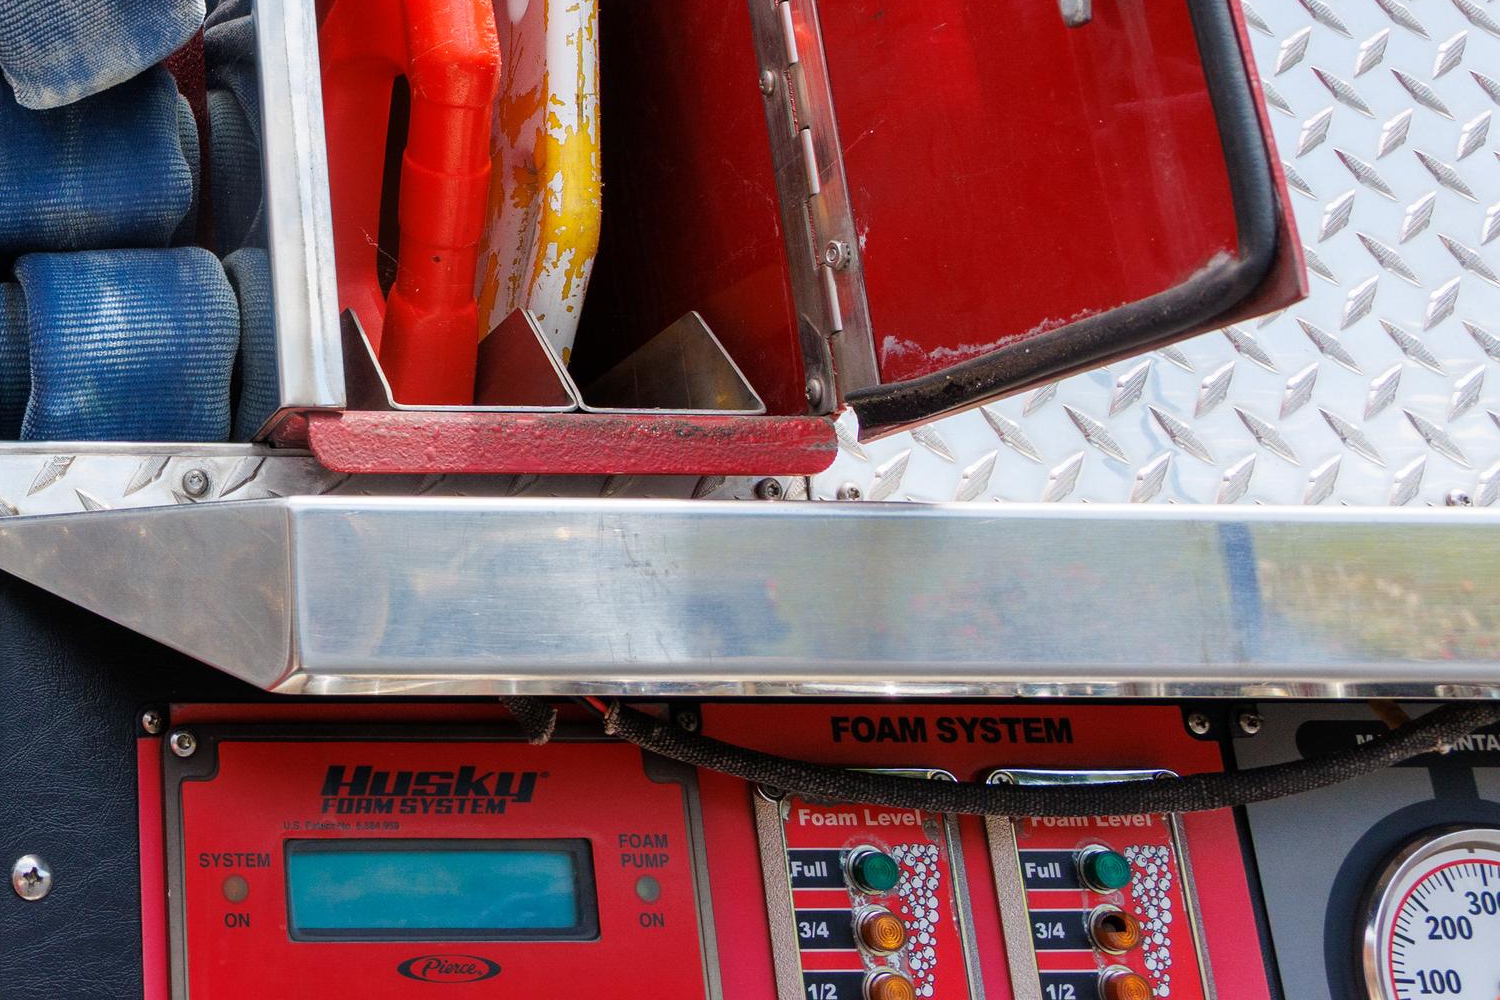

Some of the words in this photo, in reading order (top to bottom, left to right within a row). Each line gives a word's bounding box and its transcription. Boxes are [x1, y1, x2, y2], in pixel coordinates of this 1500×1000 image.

[831, 717, 927, 743] FOAM
[938, 717, 1073, 744] SYSTEM
[321, 765, 538, 803] Husky
[322, 797, 393, 814] FOAM
[400, 799, 506, 814] SYSTEM
[798, 808, 858, 827] Foam
[864, 809, 922, 827] Level
[618, 834, 668, 848] FOAM
[199, 853, 271, 868] SYSTEM
[621, 853, 670, 868] PUMP
[791, 861, 828, 877] Full
[1025, 862, 1061, 878] Full
[224, 913, 250, 928] ON
[639, 913, 665, 928] ON
[1425, 916, 1473, 940] 200
[799, 922, 830, 939] 3/4
[1035, 922, 1065, 939] 3/4
[421, 957, 477, 977] Pierce
[1416, 970, 1461, 994] 100
[807, 983, 838, 1000] 1/2
[1045, 983, 1076, 1000] 1/2
